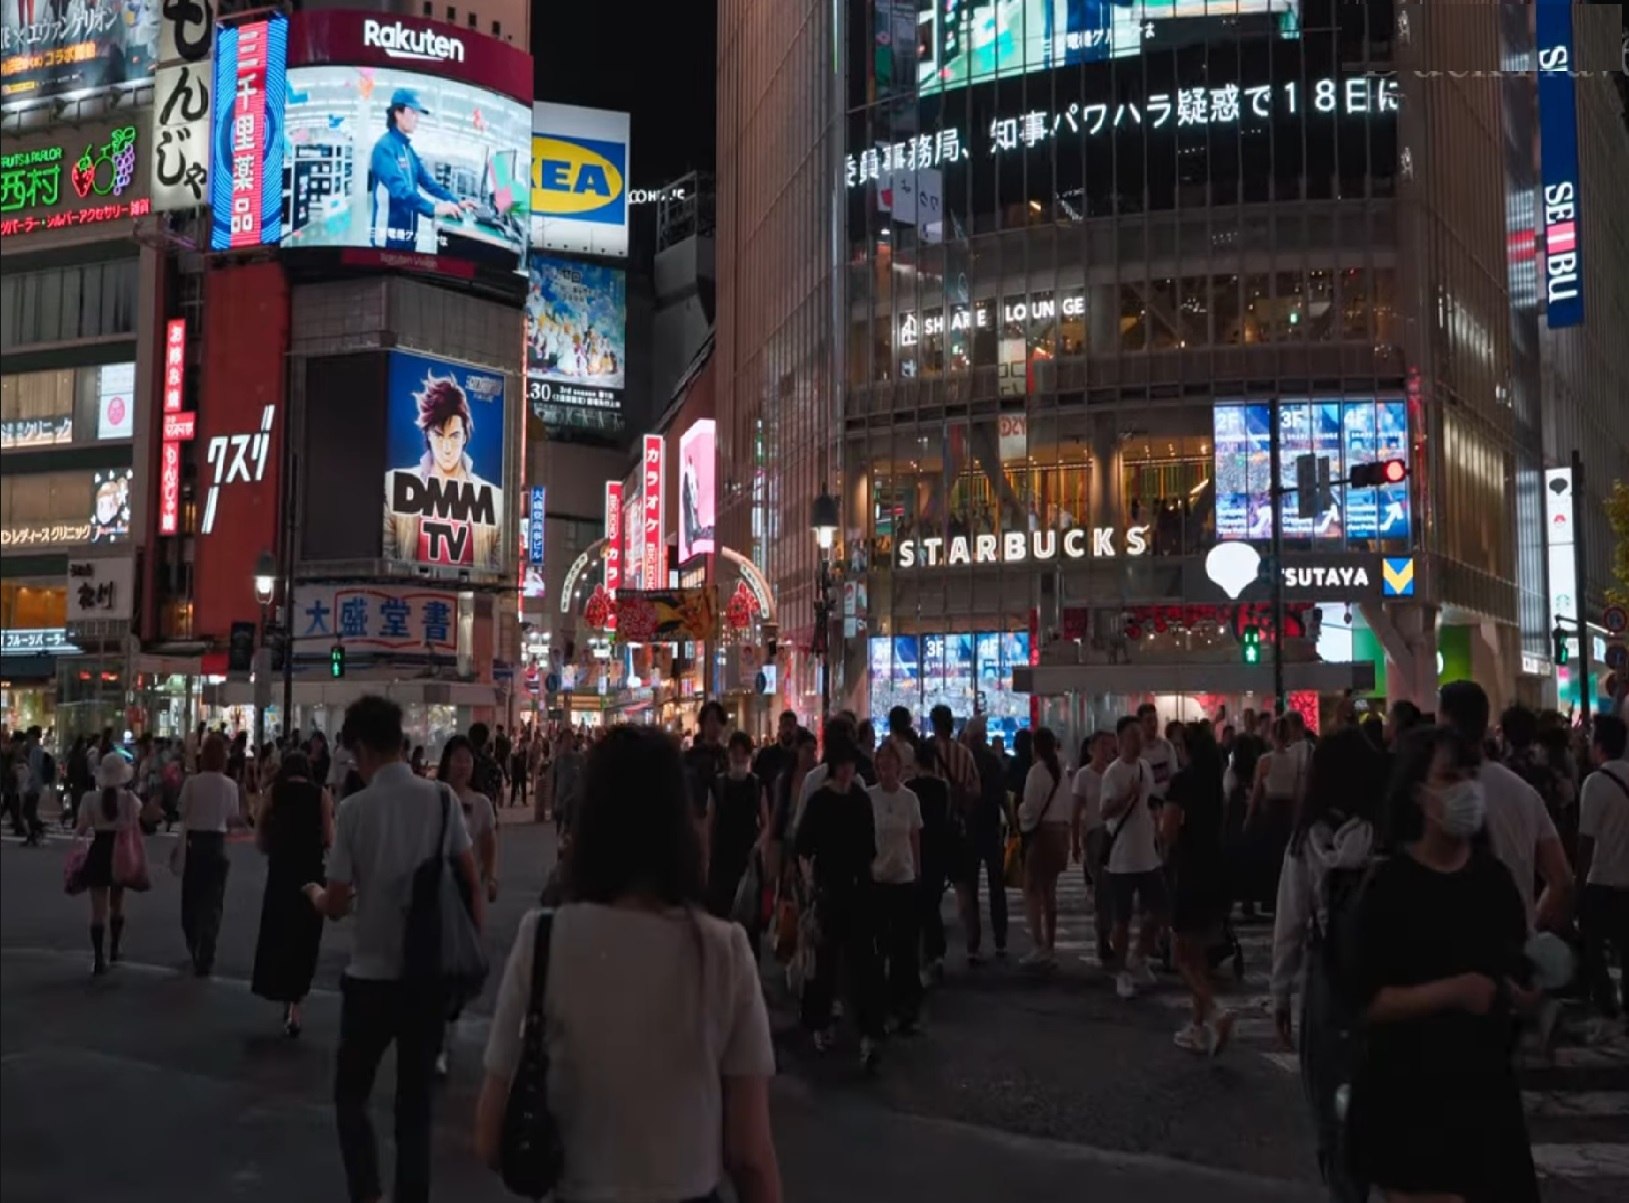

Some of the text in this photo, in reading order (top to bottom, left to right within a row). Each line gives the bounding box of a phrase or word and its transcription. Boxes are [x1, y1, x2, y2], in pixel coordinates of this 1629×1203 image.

[364, 19, 464, 62] Rakuten
[230, 30, 262, 234] 三千里薬品
[1545, 181, 1579, 304] SEIBU
[925, 297, 1085, 335] SHARE LOUNGE
[1281, 411, 1304, 428] 3F
[201, 404, 275, 534] クスリ
[645, 448, 659, 531] カラオケ
[393, 470, 496, 526] DMM
[423, 521, 467, 560] TV
[899, 526, 1146, 568] STARBUCKS
[1281, 566, 1369, 587] SUTAYA
[305, 597, 451, 640] 大盛堂書
[927, 640, 944, 657] 3F
